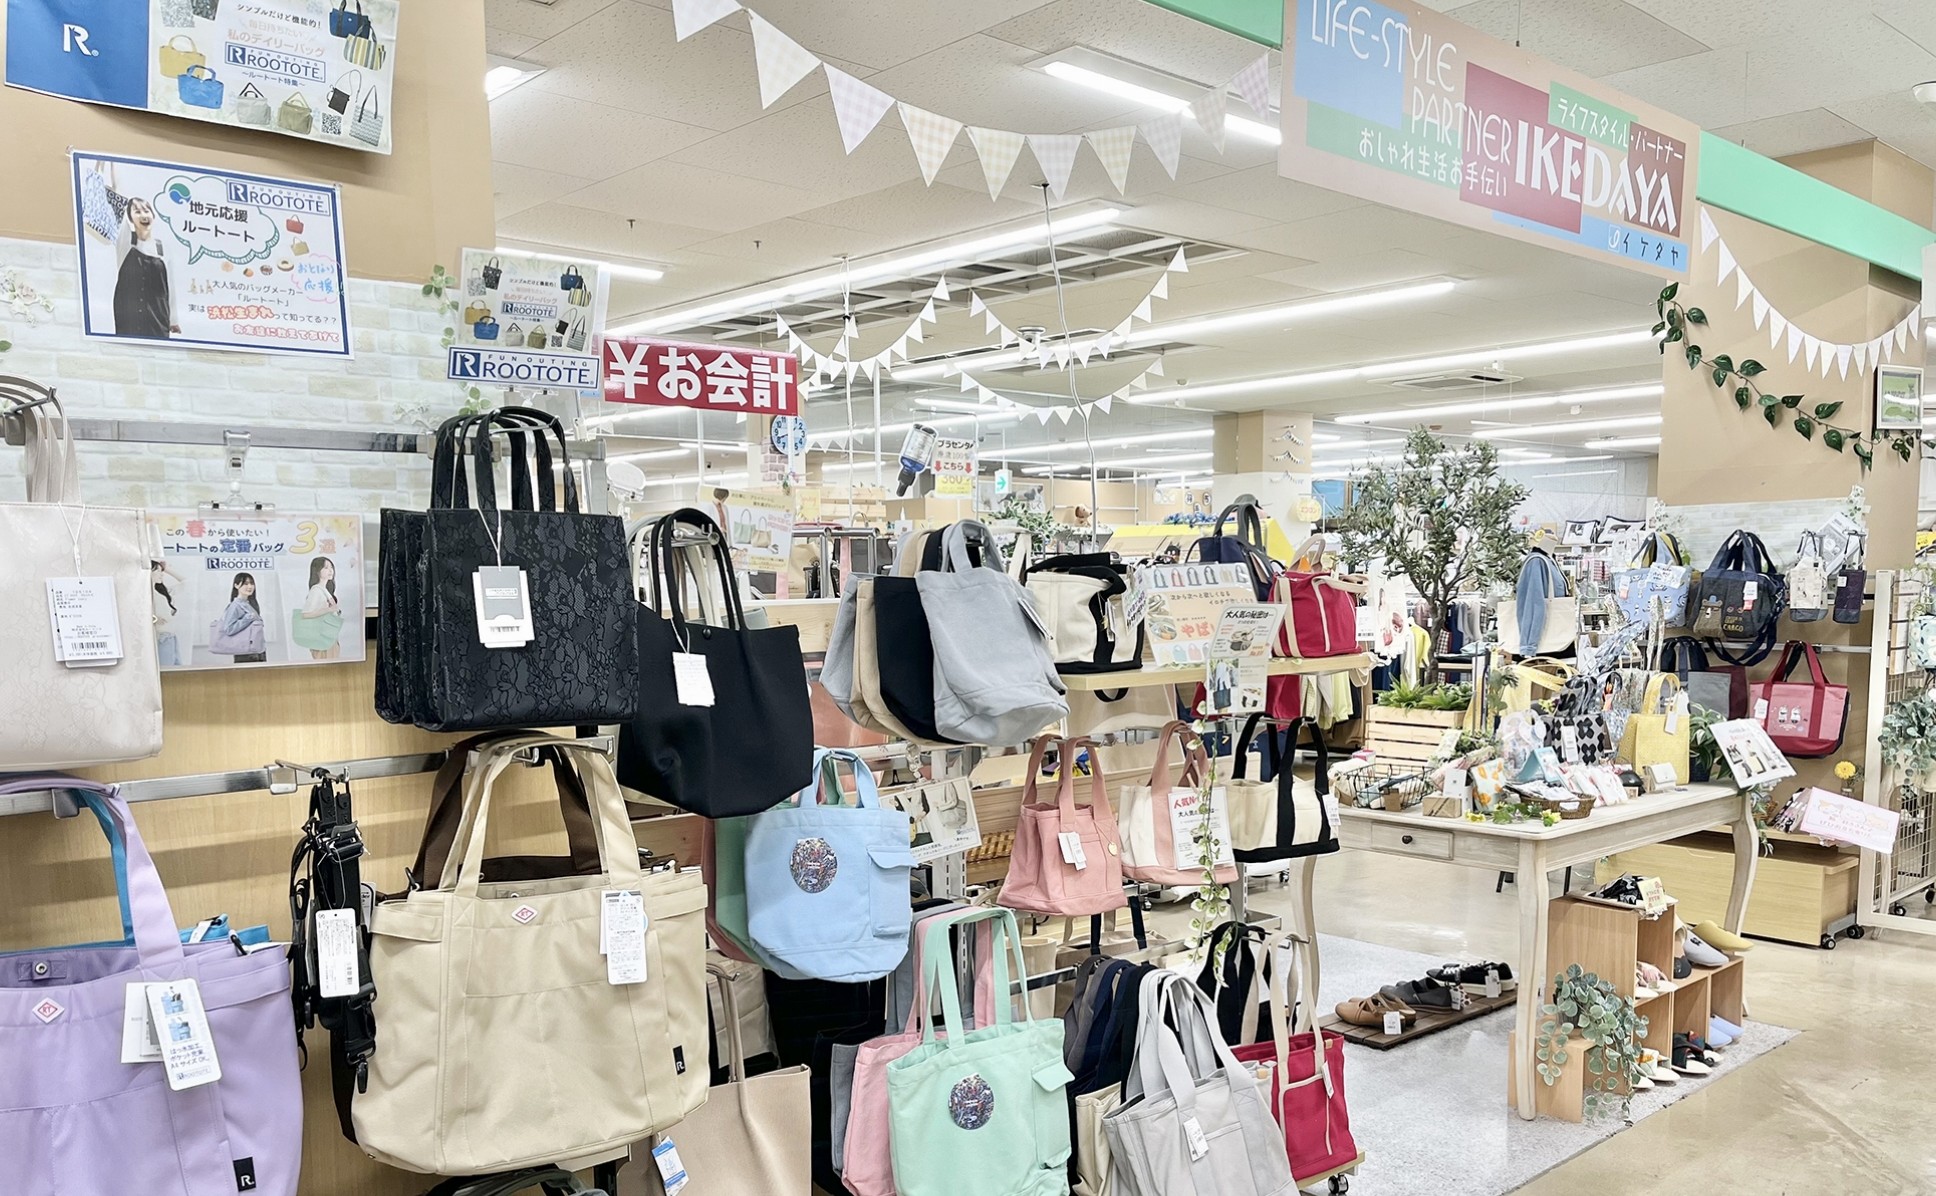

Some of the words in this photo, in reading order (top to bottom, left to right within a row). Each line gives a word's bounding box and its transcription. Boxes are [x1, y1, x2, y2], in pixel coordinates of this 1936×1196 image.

[1311, 0, 1457, 92] LIFE-STYLE
[247, 54, 322, 80] ROOTOTE
[1411, 86, 1511, 166] PARTNER
[1557, 98, 1683, 160] ライフスタイル・パートナー
[1359, 128, 1508, 198] おしゃれ生活お手伝い
[1515, 119, 1677, 233] IKEDAYA
[190, 200, 248, 223] 地元応援
[250, 191, 328, 214] ROOTOTE
[183, 220, 255, 243] ルートート
[213, 280, 303, 296] 大人気のバッグメーカー
[237, 294, 290, 307] 「ルートート」
[513, 306, 553, 317] ROOTOTE
[488, 354, 517, 362] FUN
[526, 356, 587, 367] OUTING
[483, 361, 590, 385] ROOTOTE
[944, 461, 964, 471] こちら
[163, 538, 284, 553] ートートの定番バッグ
[220, 559, 271, 569] ROOTOTE
